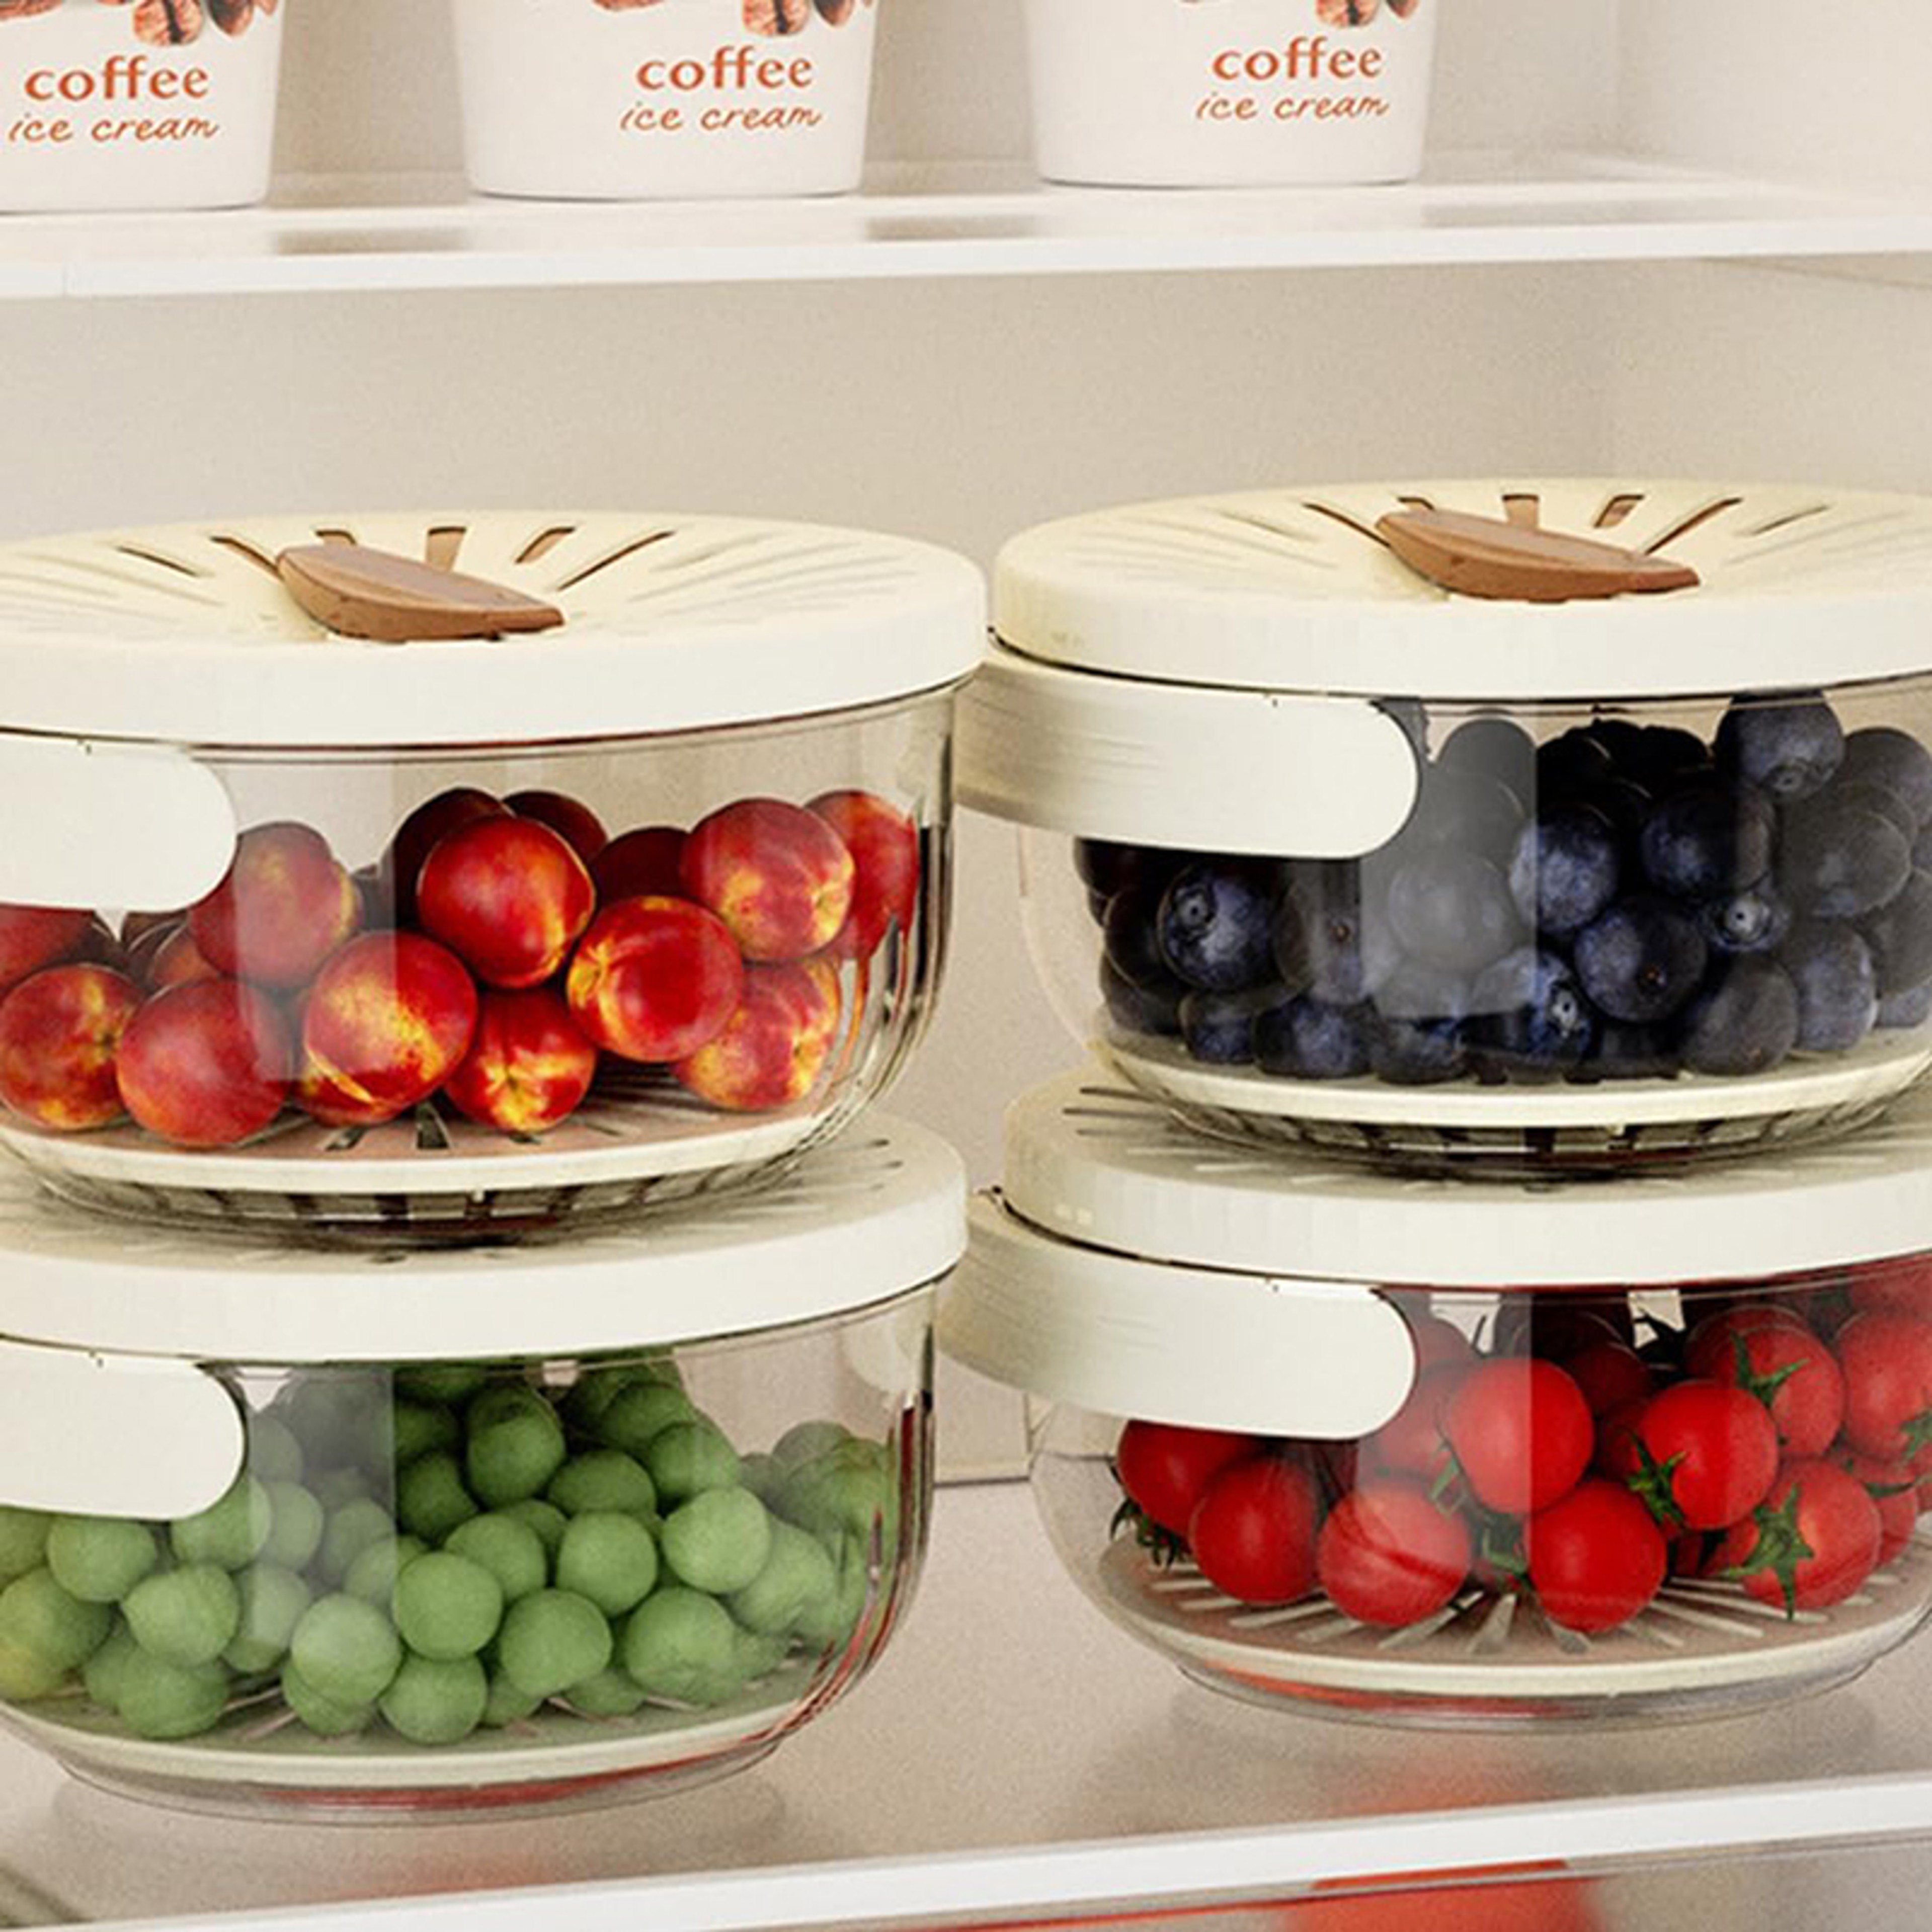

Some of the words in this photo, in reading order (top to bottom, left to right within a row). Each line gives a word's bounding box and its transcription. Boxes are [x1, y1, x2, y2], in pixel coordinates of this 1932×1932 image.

[635, 44, 814, 91] coffee
[1211, 35, 1383, 80] coffee
[24, 54, 209, 101] coffee
[619, 101, 683, 131] ice
[700, 106, 822, 130] cream
[1195, 92, 1258, 120] ice
[1273, 96, 1390, 120] cream
[8, 113, 74, 143] ice
[91, 117, 219, 143] cream
